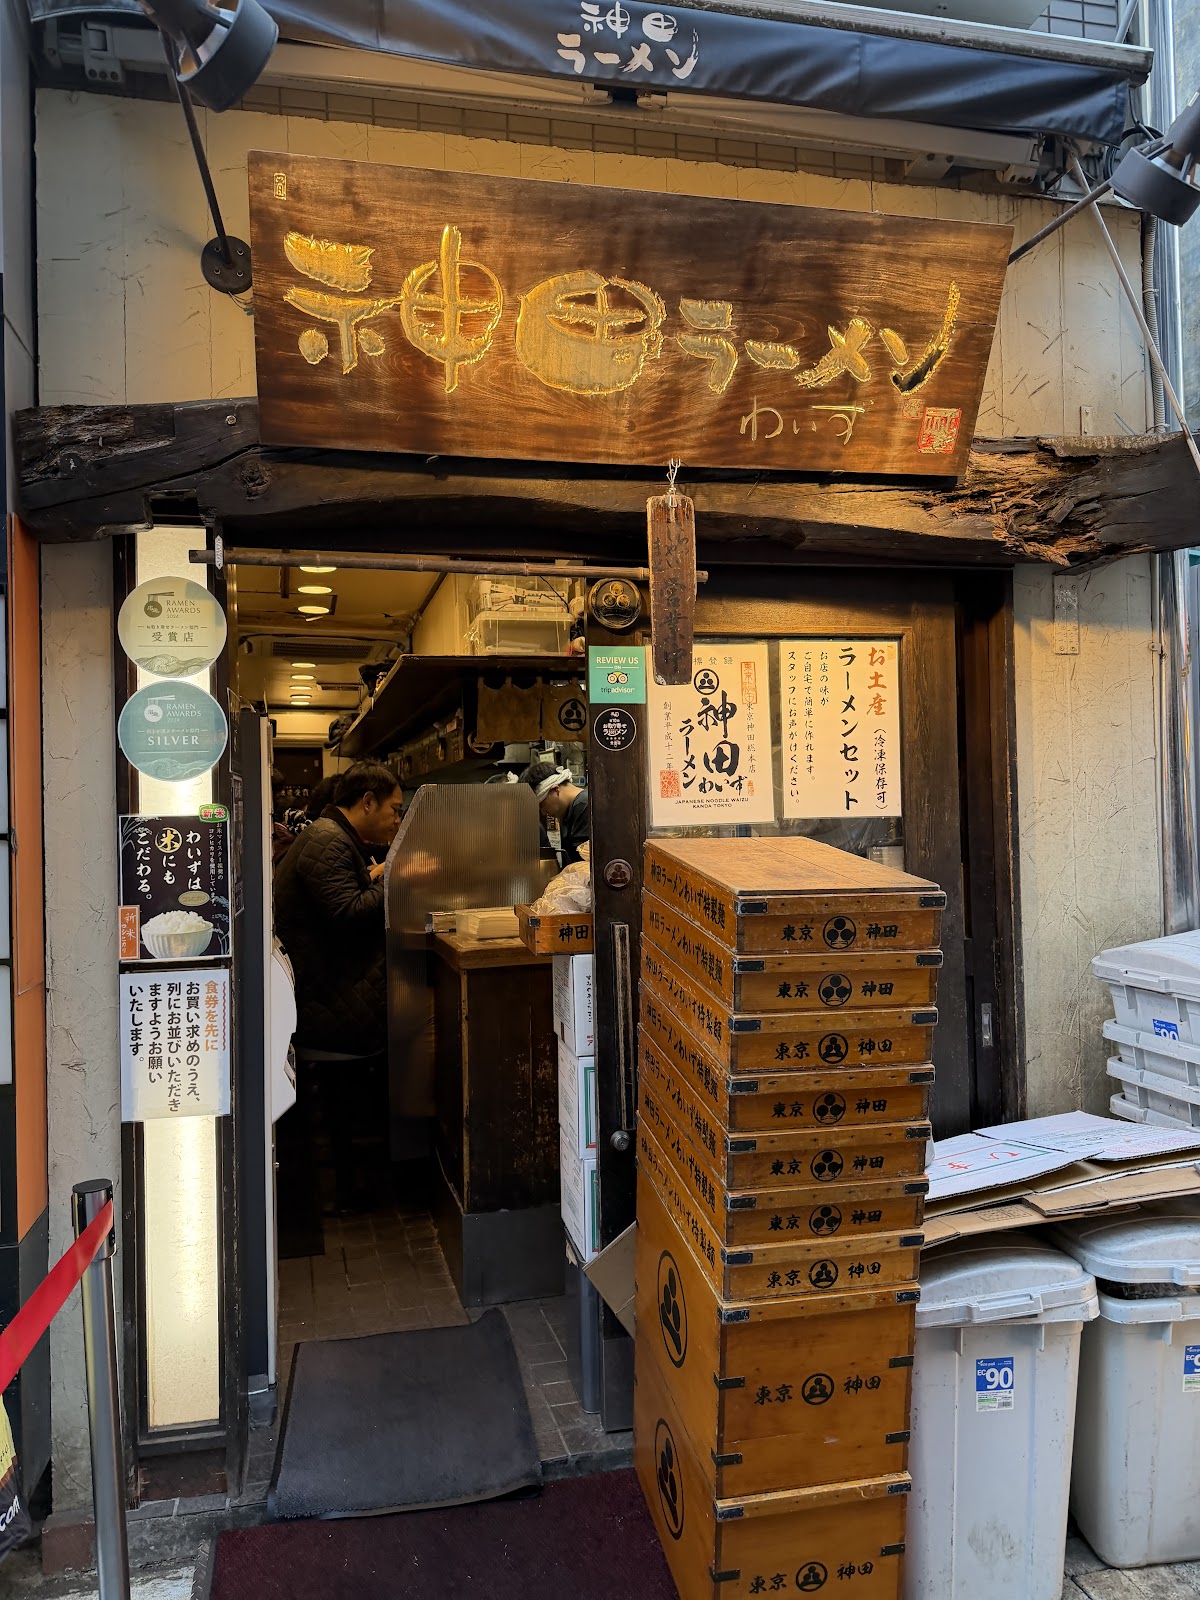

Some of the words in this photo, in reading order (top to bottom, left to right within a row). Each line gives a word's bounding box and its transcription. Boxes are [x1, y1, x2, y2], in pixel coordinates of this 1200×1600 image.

[557, 28, 699, 79] ラーメン
[740, 399, 871, 446] わいず
[152, 631, 194, 642] 受賞店
[596, 656, 626, 664] REVIEW
[628, 656, 639, 664] US
[819, 651, 830, 707] お店の味が
[866, 646, 887, 716] お土産
[148, 735, 199, 746] SILVER
[663, 701, 674, 771] 創業平成十二年
[697, 690, 740, 777] 神田
[788, 651, 800, 803] スタッフにお声がけください。
[803, 651, 815, 781] ご自宅で簡単に作れます。
[838, 646, 860, 811] ラーメンセット
[679, 718, 698, 789] ラーメン
[698, 775, 748, 796] わいず
[202, 808, 226, 819] 新米
[136, 832, 152, 900] こだわる。
[160, 829, 180, 884] 米にも
[185, 830, 201, 890] わいずは
[559, 922, 588, 944] 神田
[781, 924, 814, 941] 東京
[866, 923, 898, 940] 神田
[776, 982, 810, 998] 東京
[861, 981, 894, 997] 神田
[128, 984, 144, 1063] いたします。
[148, 983, 163, 1084] ますようお願い
[204, 980, 219, 1051] 食券を先に
[166, 981, 181, 1112] 列にお並びいただき
[185, 981, 201, 1102] お買い求めのうえ、
[774, 1041, 810, 1060] 東京
[858, 1038, 893, 1055] 神田
[771, 1102, 804, 1118] 東京
[855, 1098, 888, 1115] 神田
[769, 1159, 802, 1176] 東京
[852, 1155, 885, 1171] 神田
[768, 1214, 801, 1231] 東京
[850, 1209, 883, 1225] 神田
[766, 1269, 802, 1289] 東京
[847, 1261, 882, 1279] 神田
[754, 1384, 793, 1405] 東京
[843, 1374, 882, 1395] 神田
[985, 1367, 1013, 1389] 90
[749, 1573, 788, 1595] 東京
[836, 1561, 874, 1580] 神田
